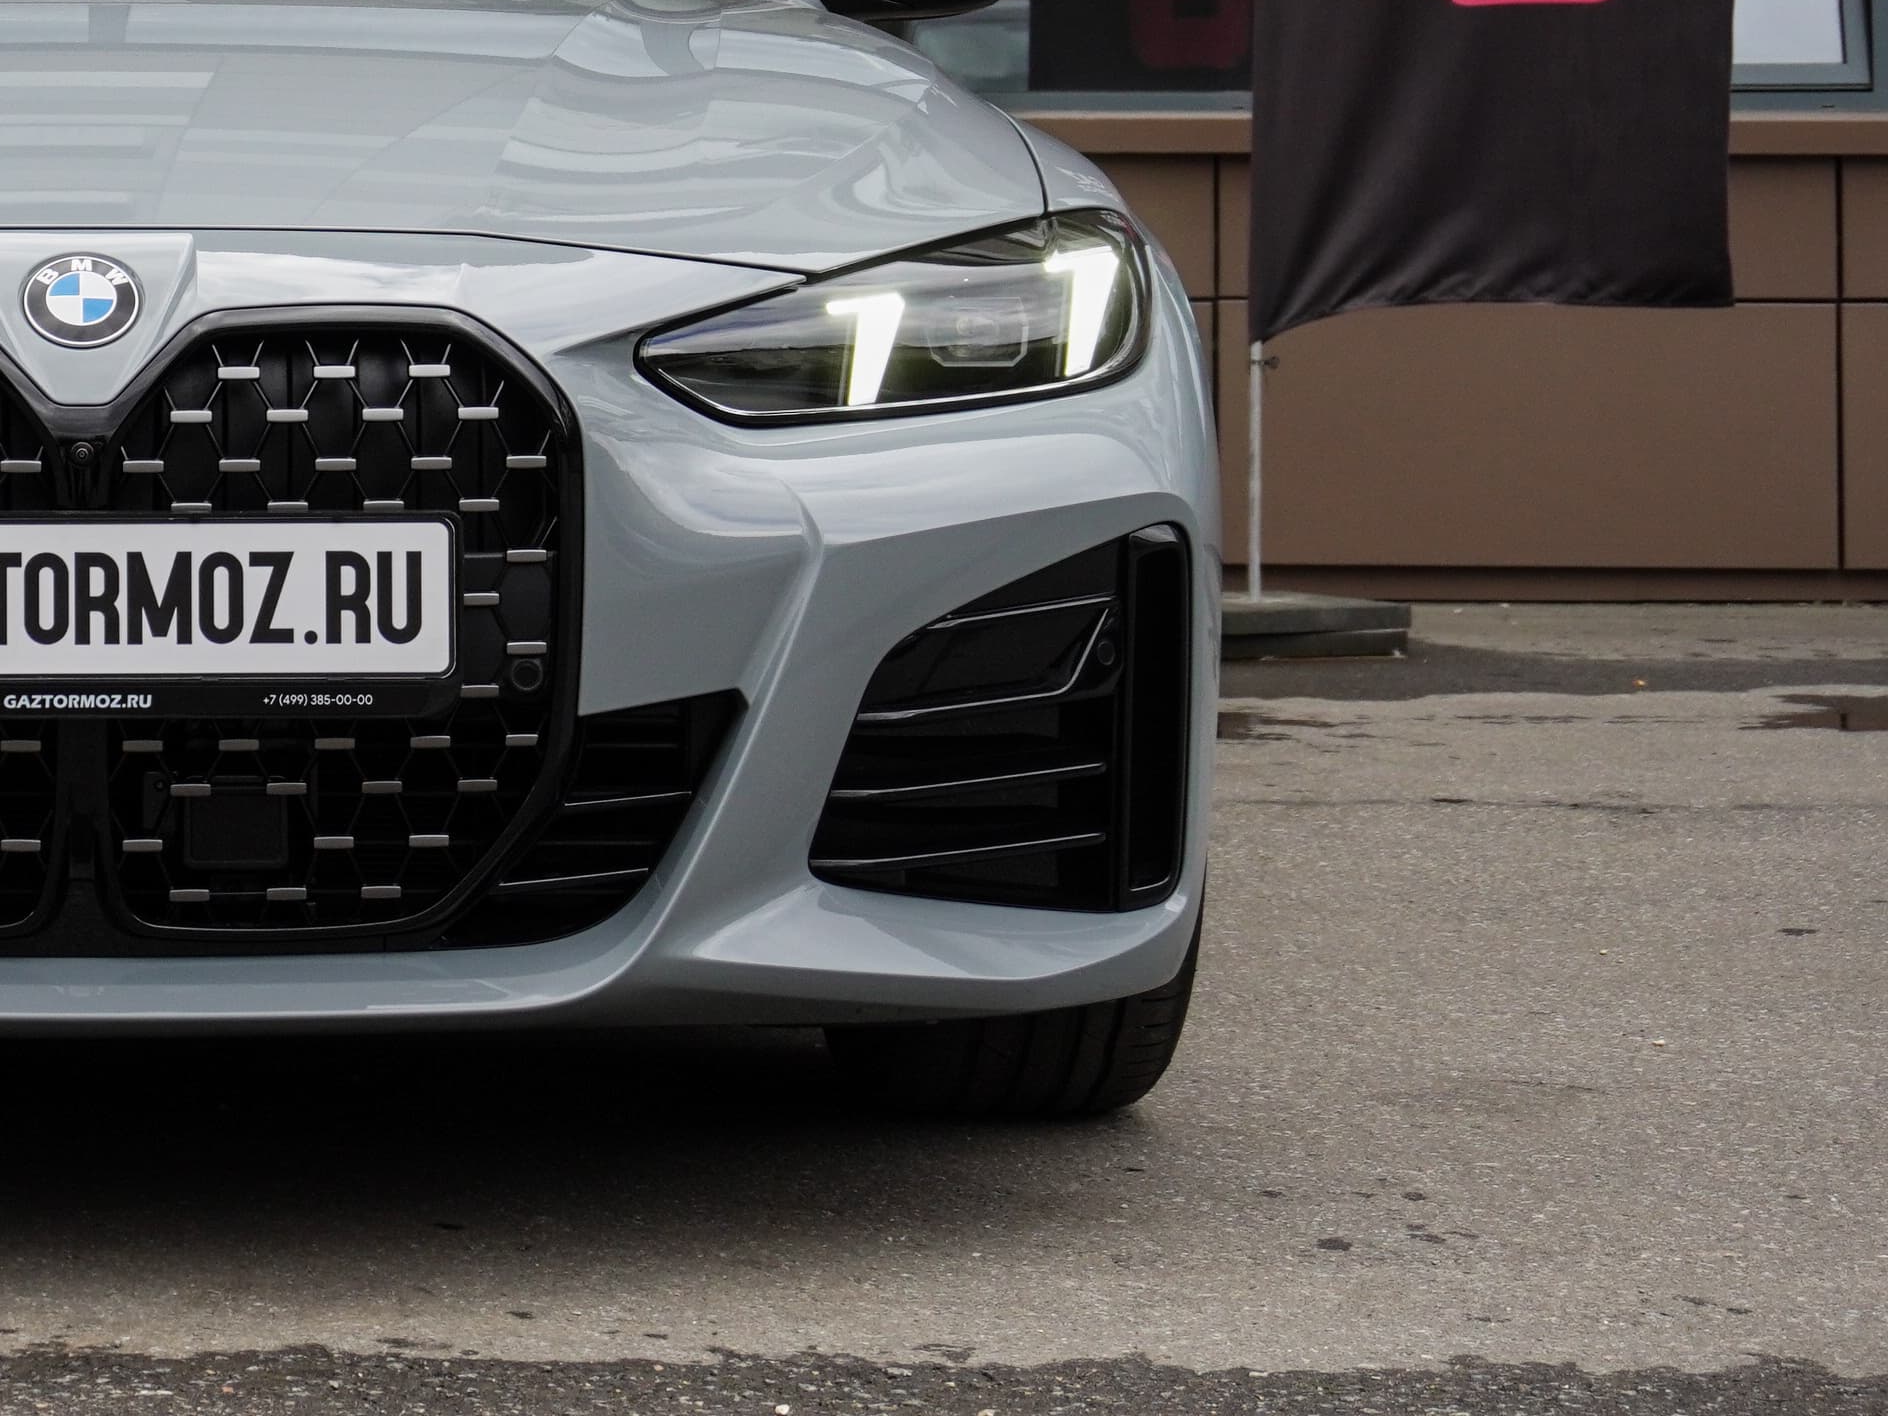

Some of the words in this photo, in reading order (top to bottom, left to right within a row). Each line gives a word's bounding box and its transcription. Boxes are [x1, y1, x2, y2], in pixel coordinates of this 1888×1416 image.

[36, 259, 129, 285] BMW
[3, 694, 152, 709] GAZTORMOZ.RU
[263, 694, 276, 705] +7
[279, 693, 308, 706] (499)
[311, 694, 374, 705] 385-00-00
